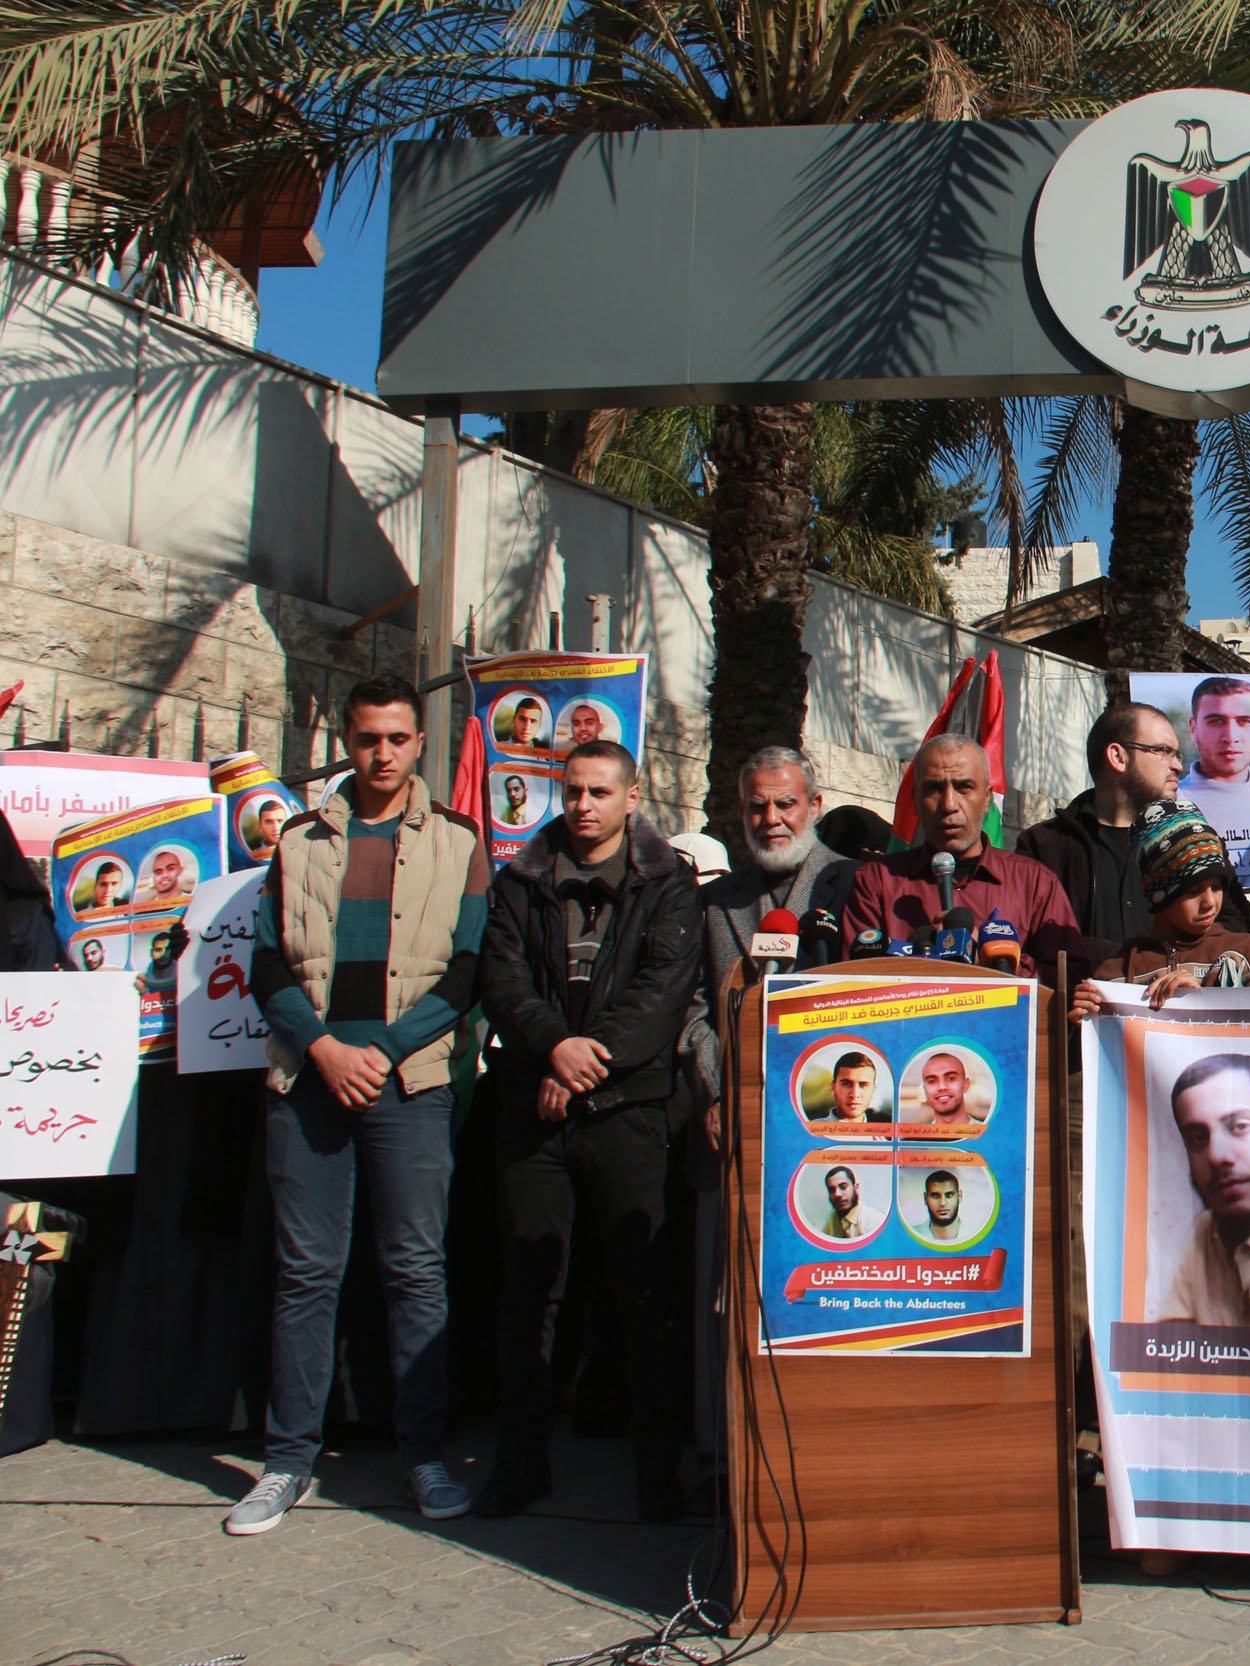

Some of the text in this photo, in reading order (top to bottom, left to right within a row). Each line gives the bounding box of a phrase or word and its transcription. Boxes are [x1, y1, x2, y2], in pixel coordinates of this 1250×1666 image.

[1100, 305, 1205, 355] الوزراء
[58, 793, 130, 818] السفر
[0, 998, 60, 1031] تصريحا
[803, 994, 985, 1026] الاختفاء القسري جريمة ضد الإنسانية
[7, 1106, 98, 1143] جريمة
[820, 1297, 966, 1310] Bring Back the Abductees
[1146, 1338, 1195, 1362] الزبدة
